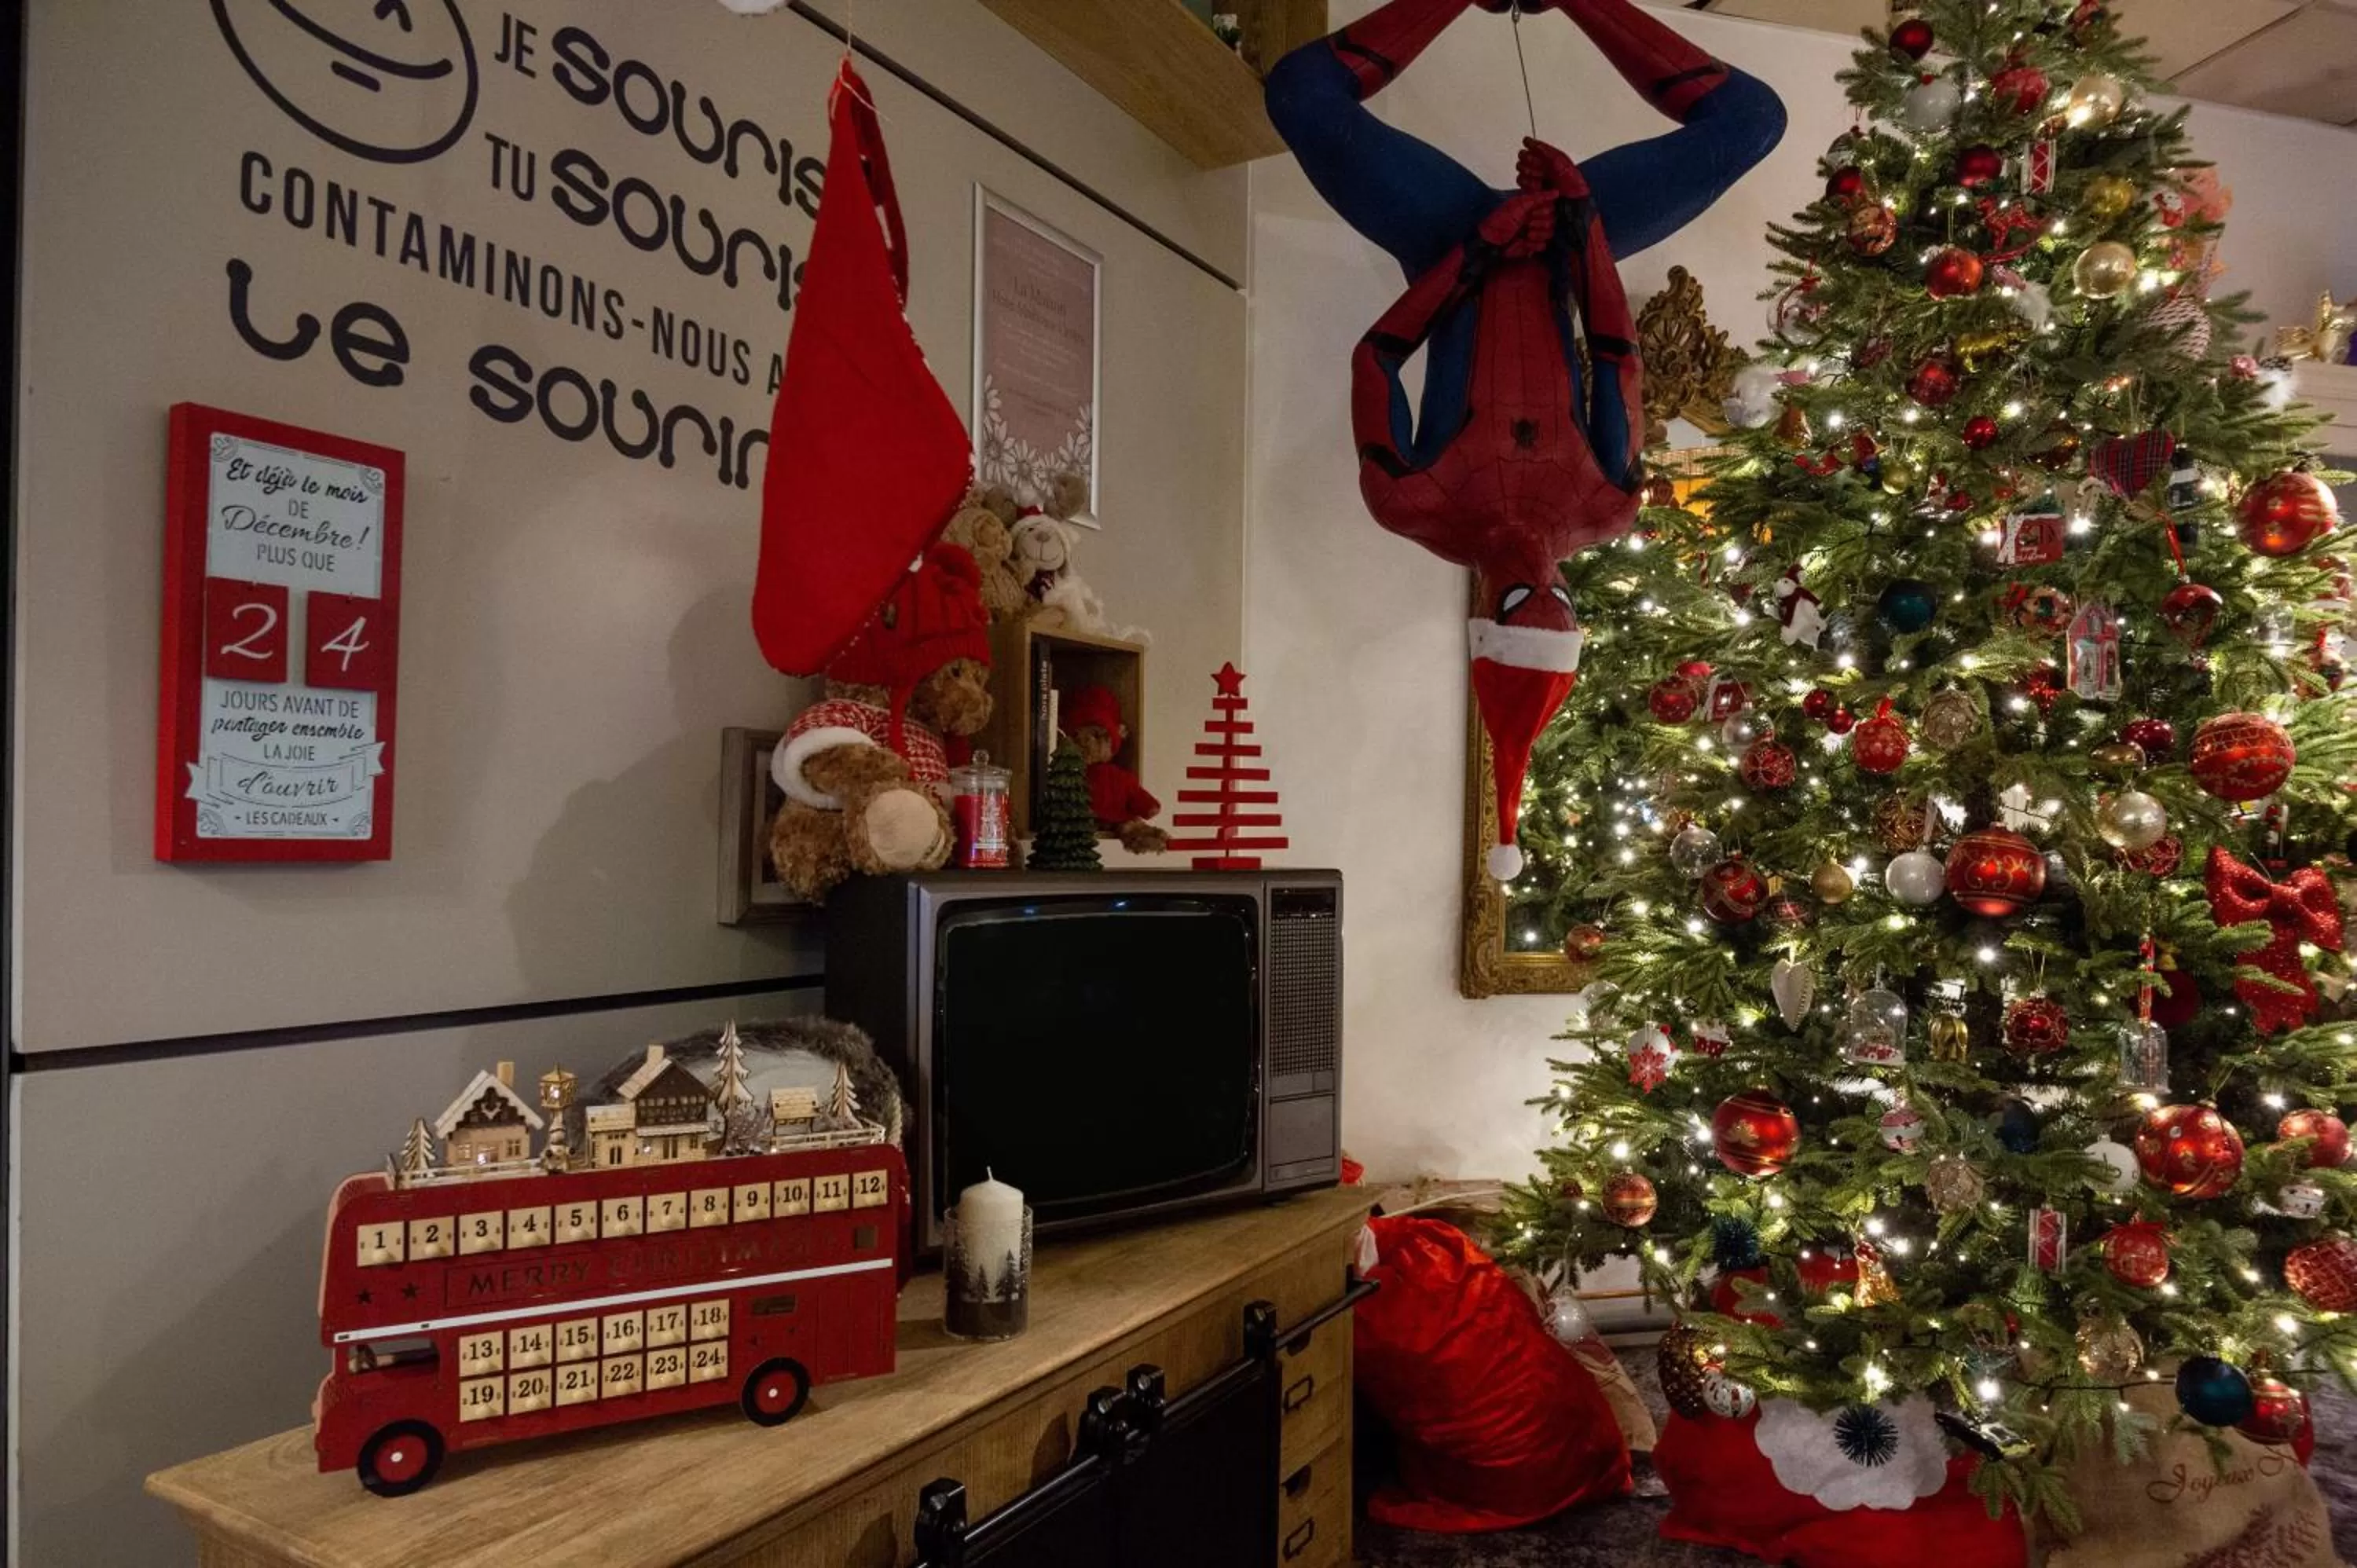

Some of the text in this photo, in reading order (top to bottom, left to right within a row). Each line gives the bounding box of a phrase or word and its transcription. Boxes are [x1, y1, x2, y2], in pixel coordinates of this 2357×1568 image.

[494, 12, 538, 79] JE
[484, 130, 536, 202] TU
[240, 151, 751, 386] CONTAMINONS-NOUS
[225, 457, 369, 504] Et déjà le mois
[288, 498, 310, 520] DE
[256, 543, 335, 573] PLUS QUE
[220, 603, 370, 672] 2 4
[219, 690, 359, 719] JOURS AVANT DE
[211, 716, 365, 742] partager ensemble
[263, 744, 315, 761] LA JOIE
[236, 770, 339, 797] d'ouvrir
[246, 811, 328, 826] LES CADEAUX
[375, 1176, 881, 1249] 1 2 3 4 5 6 7 8 9 10 11 12
[468, 1259, 590, 1296] MERRY
[469, 1306, 721, 1361] 13 14 15 16 17 18
[470, 1347, 720, 1405] 19 20 21 22 23 24
